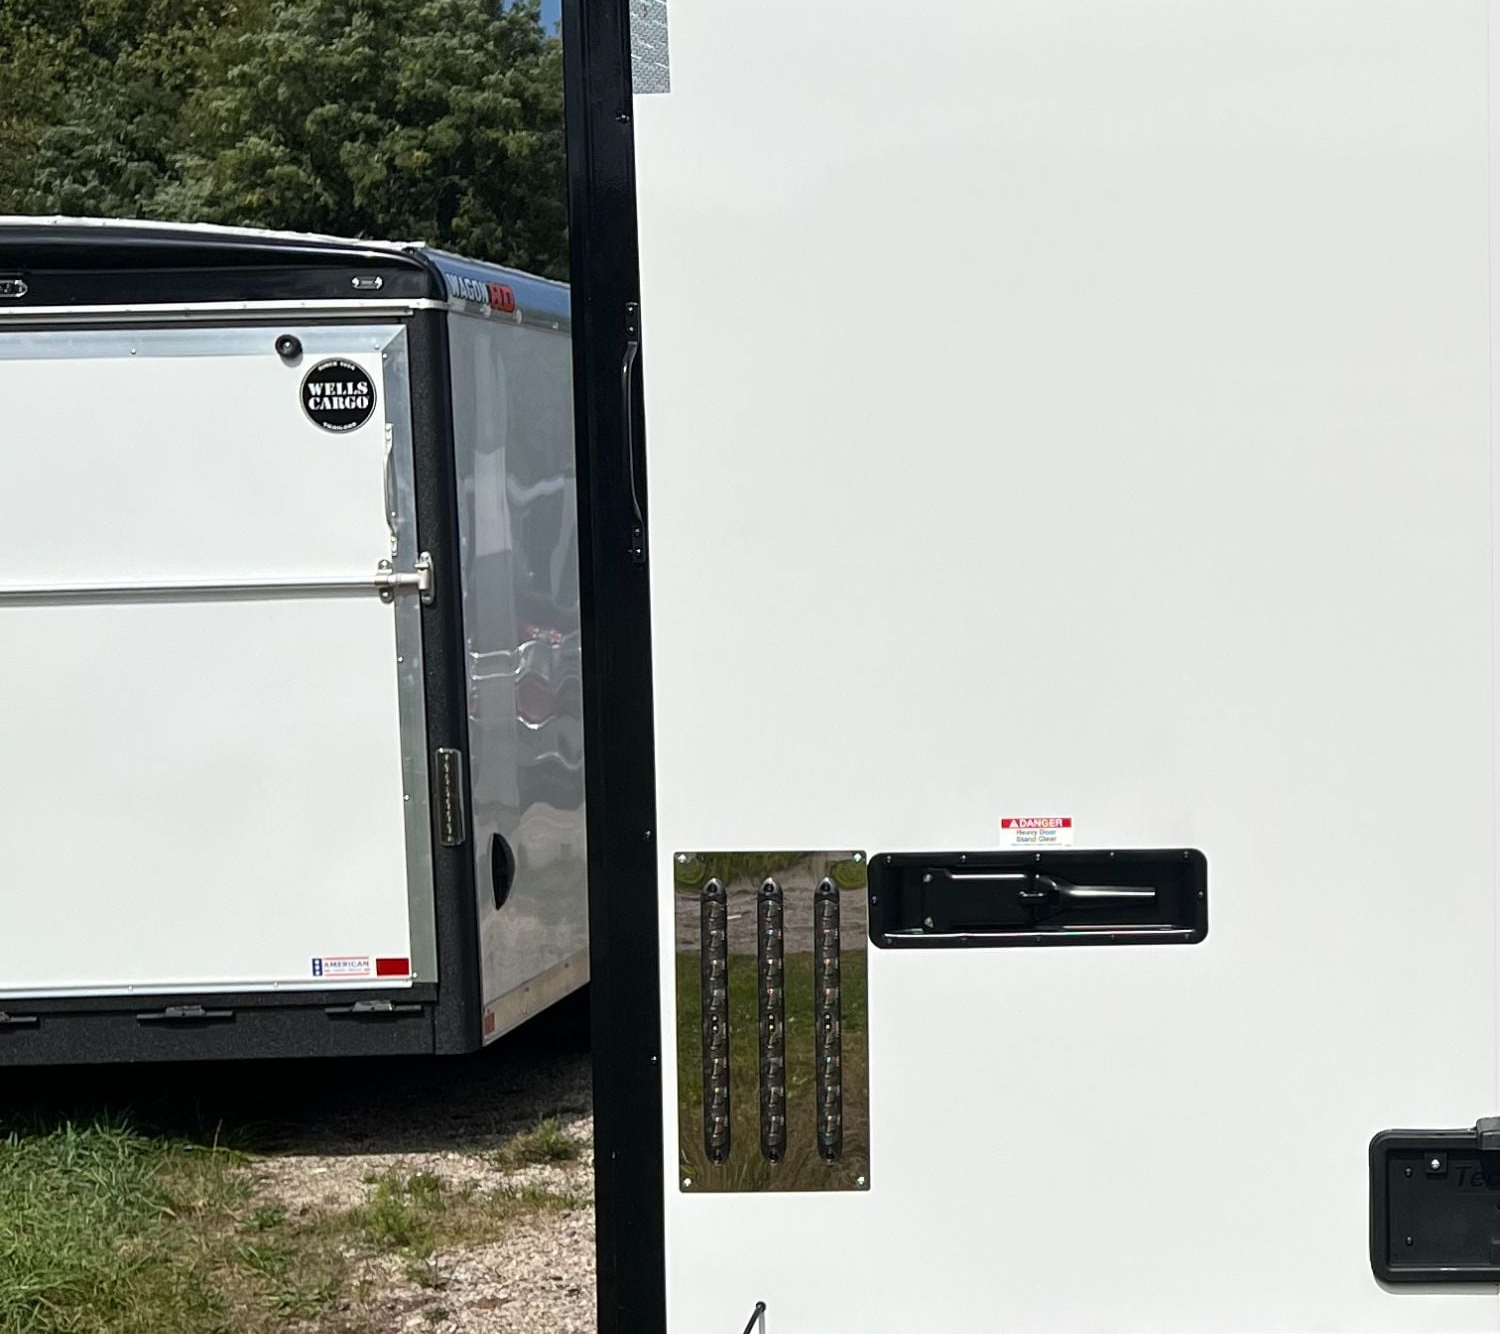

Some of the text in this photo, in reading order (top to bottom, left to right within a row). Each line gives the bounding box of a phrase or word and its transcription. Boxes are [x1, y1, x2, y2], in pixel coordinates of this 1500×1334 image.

[445, 272, 516, 314] WAGON HD
[307, 381, 369, 396] WELLS
[307, 395, 369, 411] CARGO
[1020, 818, 1063, 828] DANGER
[324, 960, 370, 968] AMERICAN
